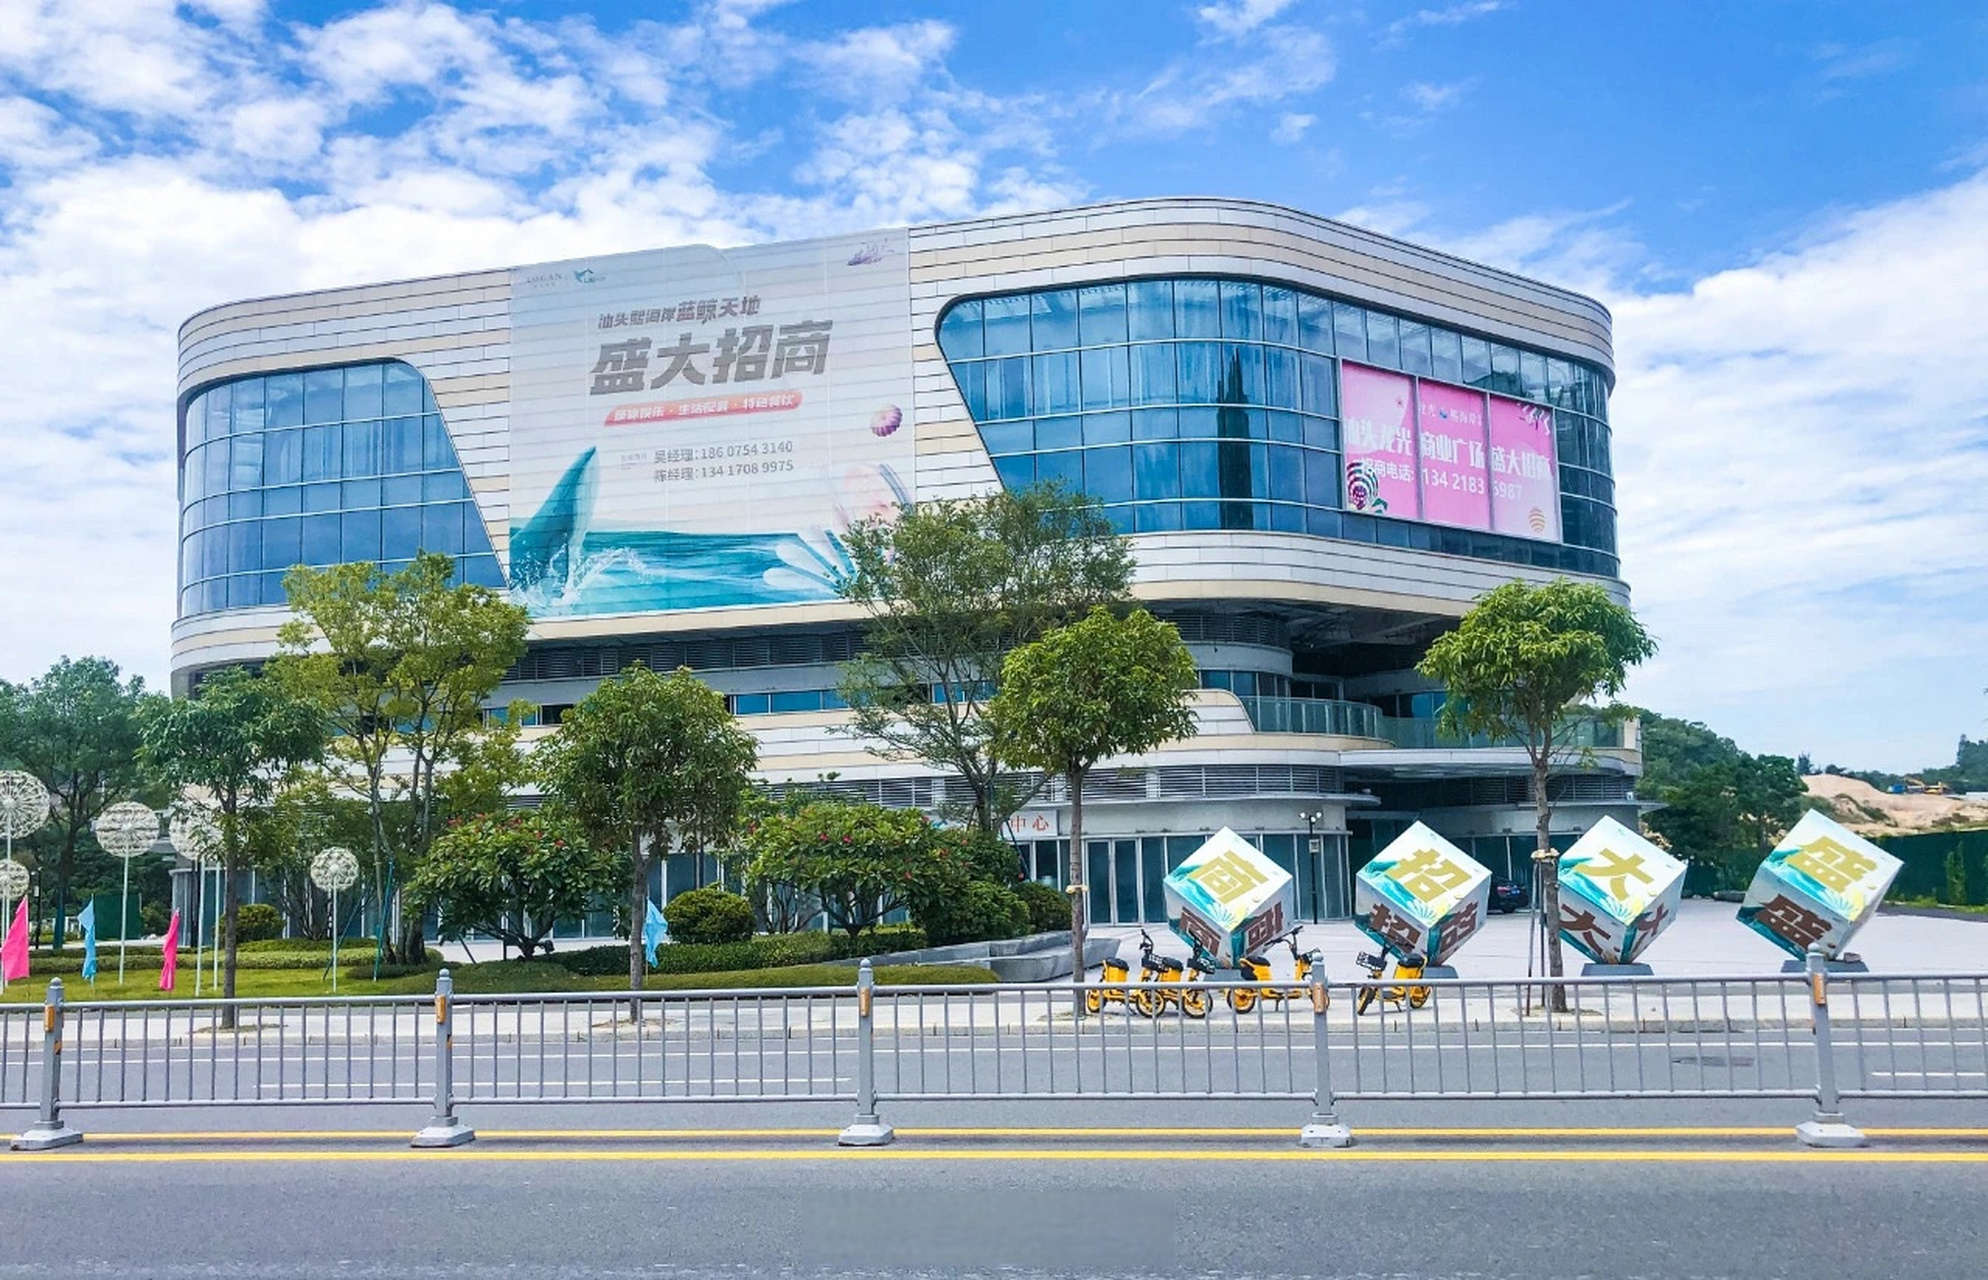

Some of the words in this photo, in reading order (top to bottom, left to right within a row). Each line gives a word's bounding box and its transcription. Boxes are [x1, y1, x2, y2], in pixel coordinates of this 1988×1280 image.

[589, 319, 833, 396] 盛大招商
[701, 446, 724, 460] 186
[727, 444, 758, 457] 0754
[762, 440, 794, 455] 3140
[701, 465, 725, 478] 134
[727, 462, 759, 476] 1708
[762, 459, 794, 473] 9975
[1421, 467, 1449, 488] 134
[1451, 472, 1486, 495] 2183
[1187, 849, 1270, 905] 商
[1384, 848, 1473, 902] 招
[1570, 847, 1655, 901] 大
[1783, 835, 1878, 893] 盛
[1558, 903, 1612, 955] 大
[1753, 893, 1833, 952] 盛
